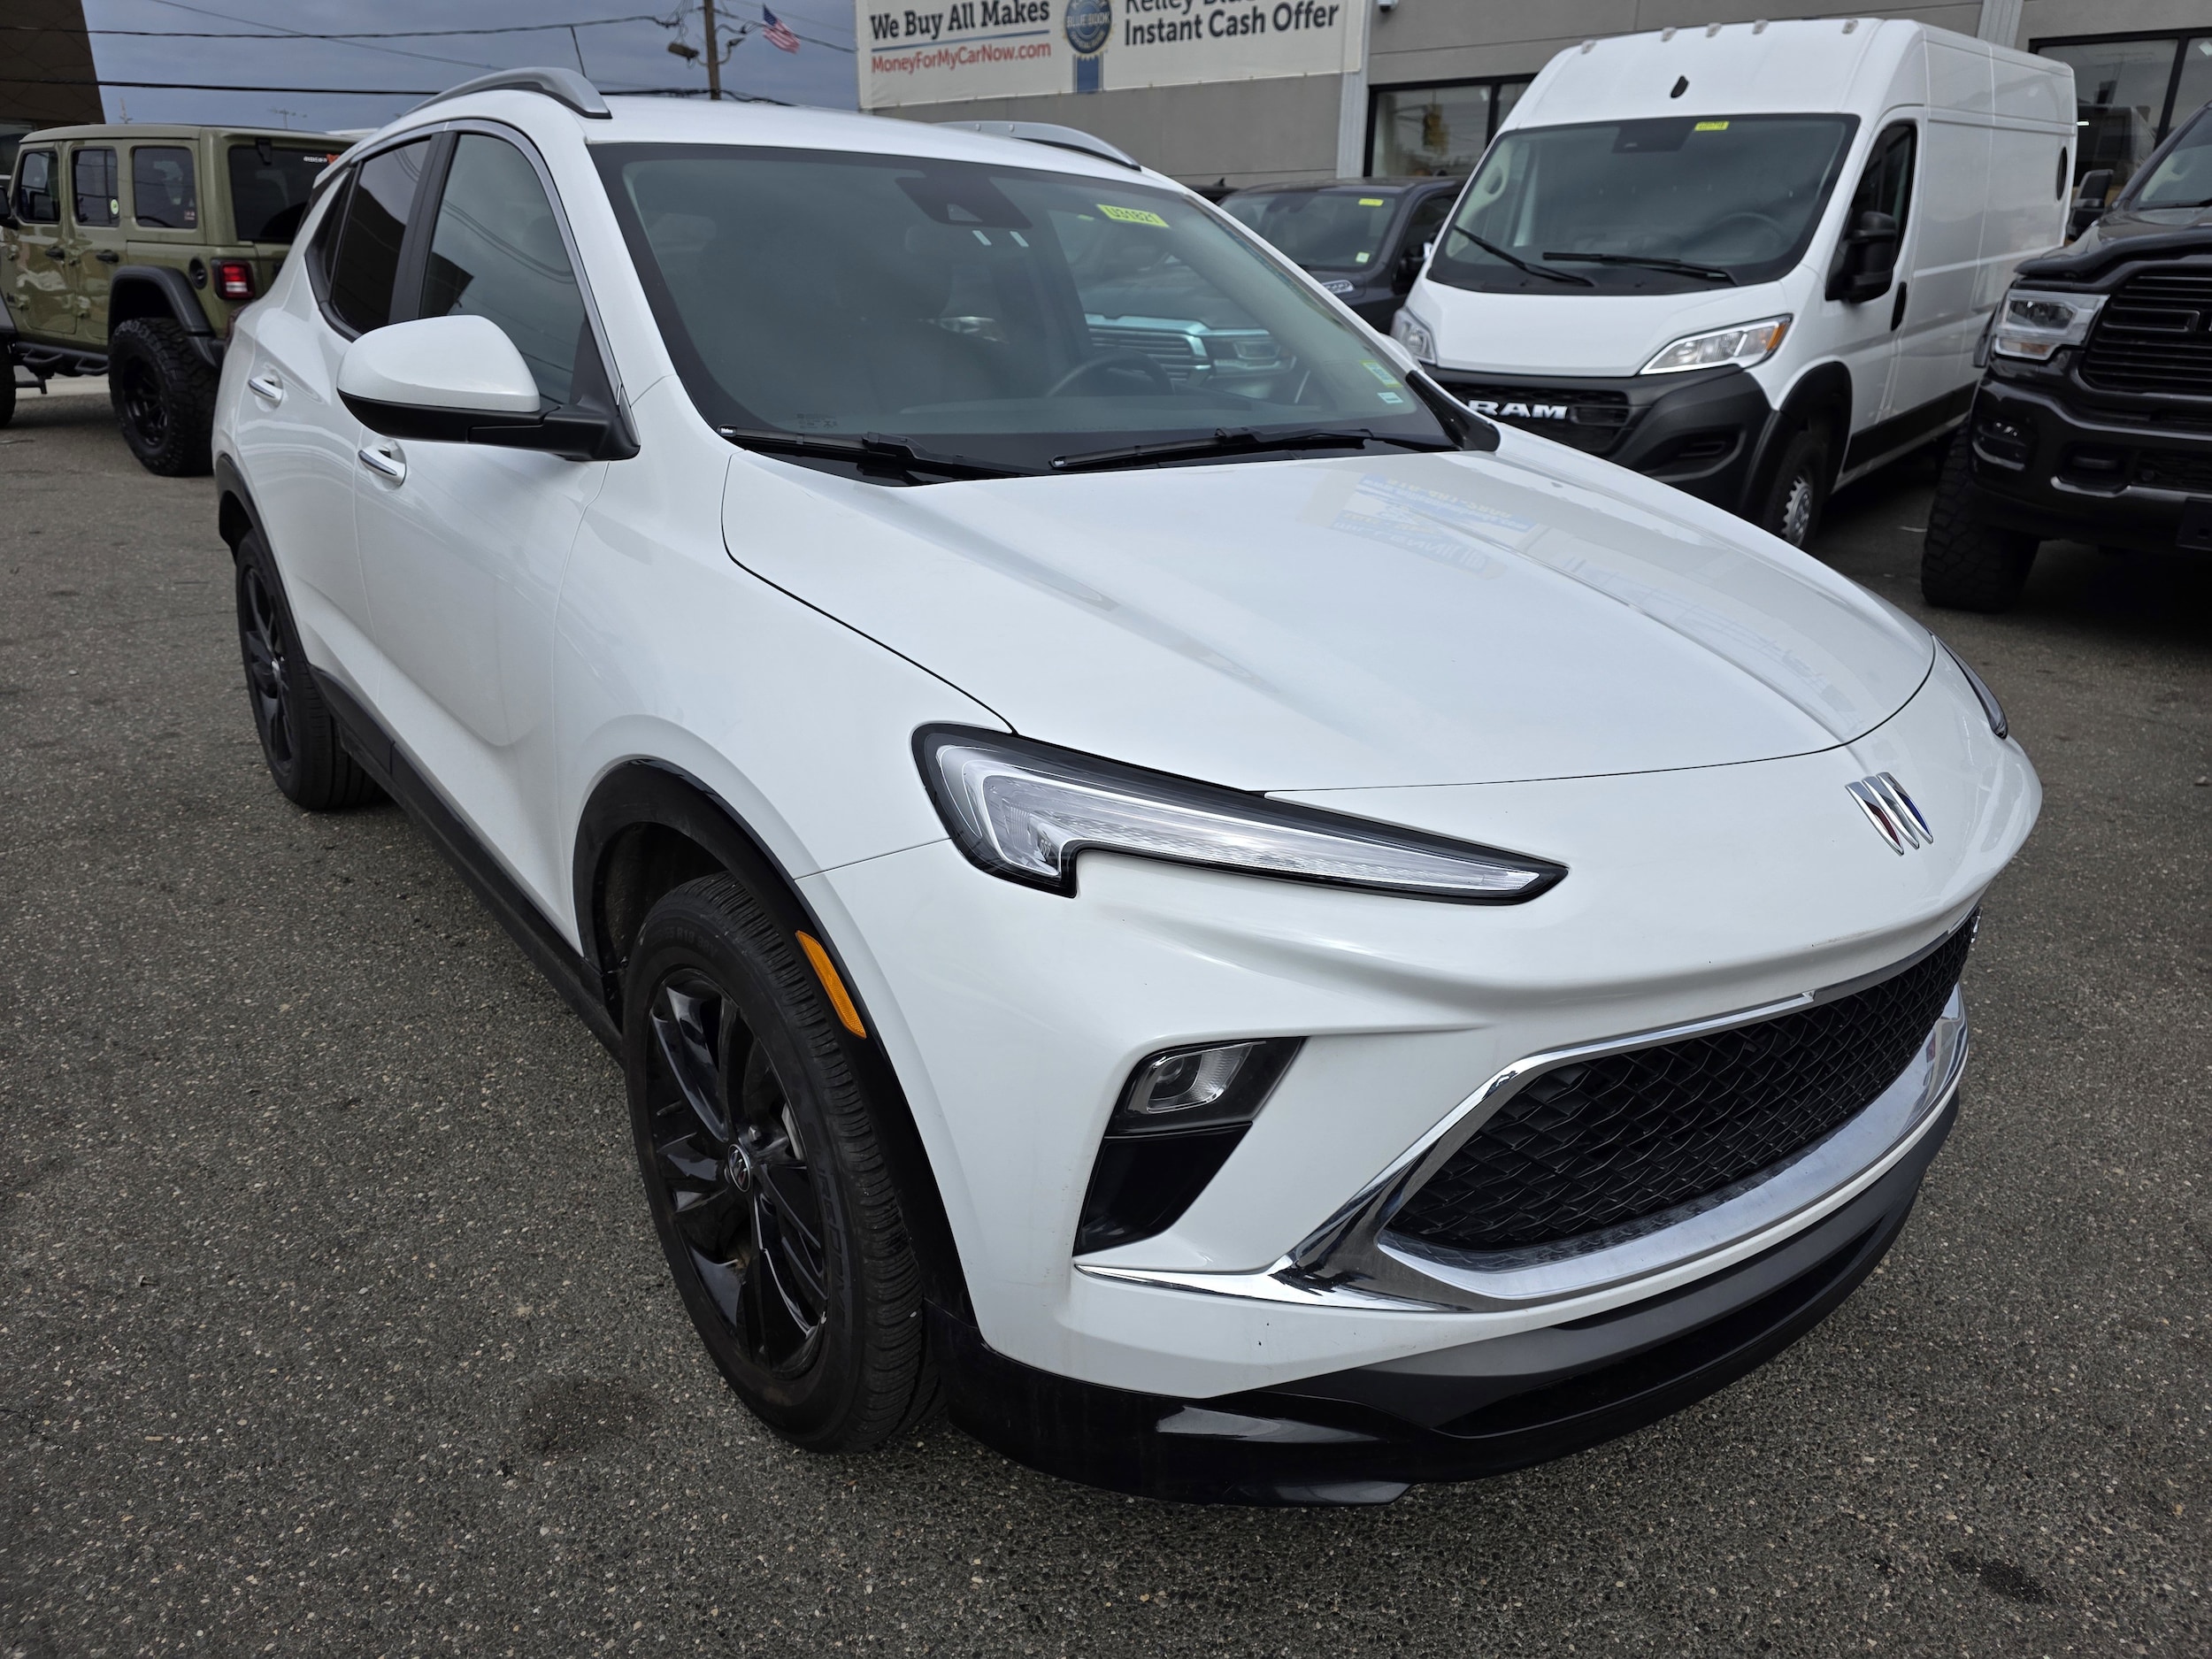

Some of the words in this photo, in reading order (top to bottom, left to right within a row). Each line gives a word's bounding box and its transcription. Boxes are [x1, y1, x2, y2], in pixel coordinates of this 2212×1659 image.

[871, 13, 899, 40] We
[904, 9, 943, 40] Buy
[949, 3, 975, 31] All
[981, 0, 1050, 26] Makes
[1125, 14, 1203, 46] Instant
[1208, 5, 1265, 37] Cash
[1272, 1, 1340, 32] Offer
[872, 42, 1052, 74] MoneyForMyCarNow.com
[1467, 400, 1569, 420] RAM
